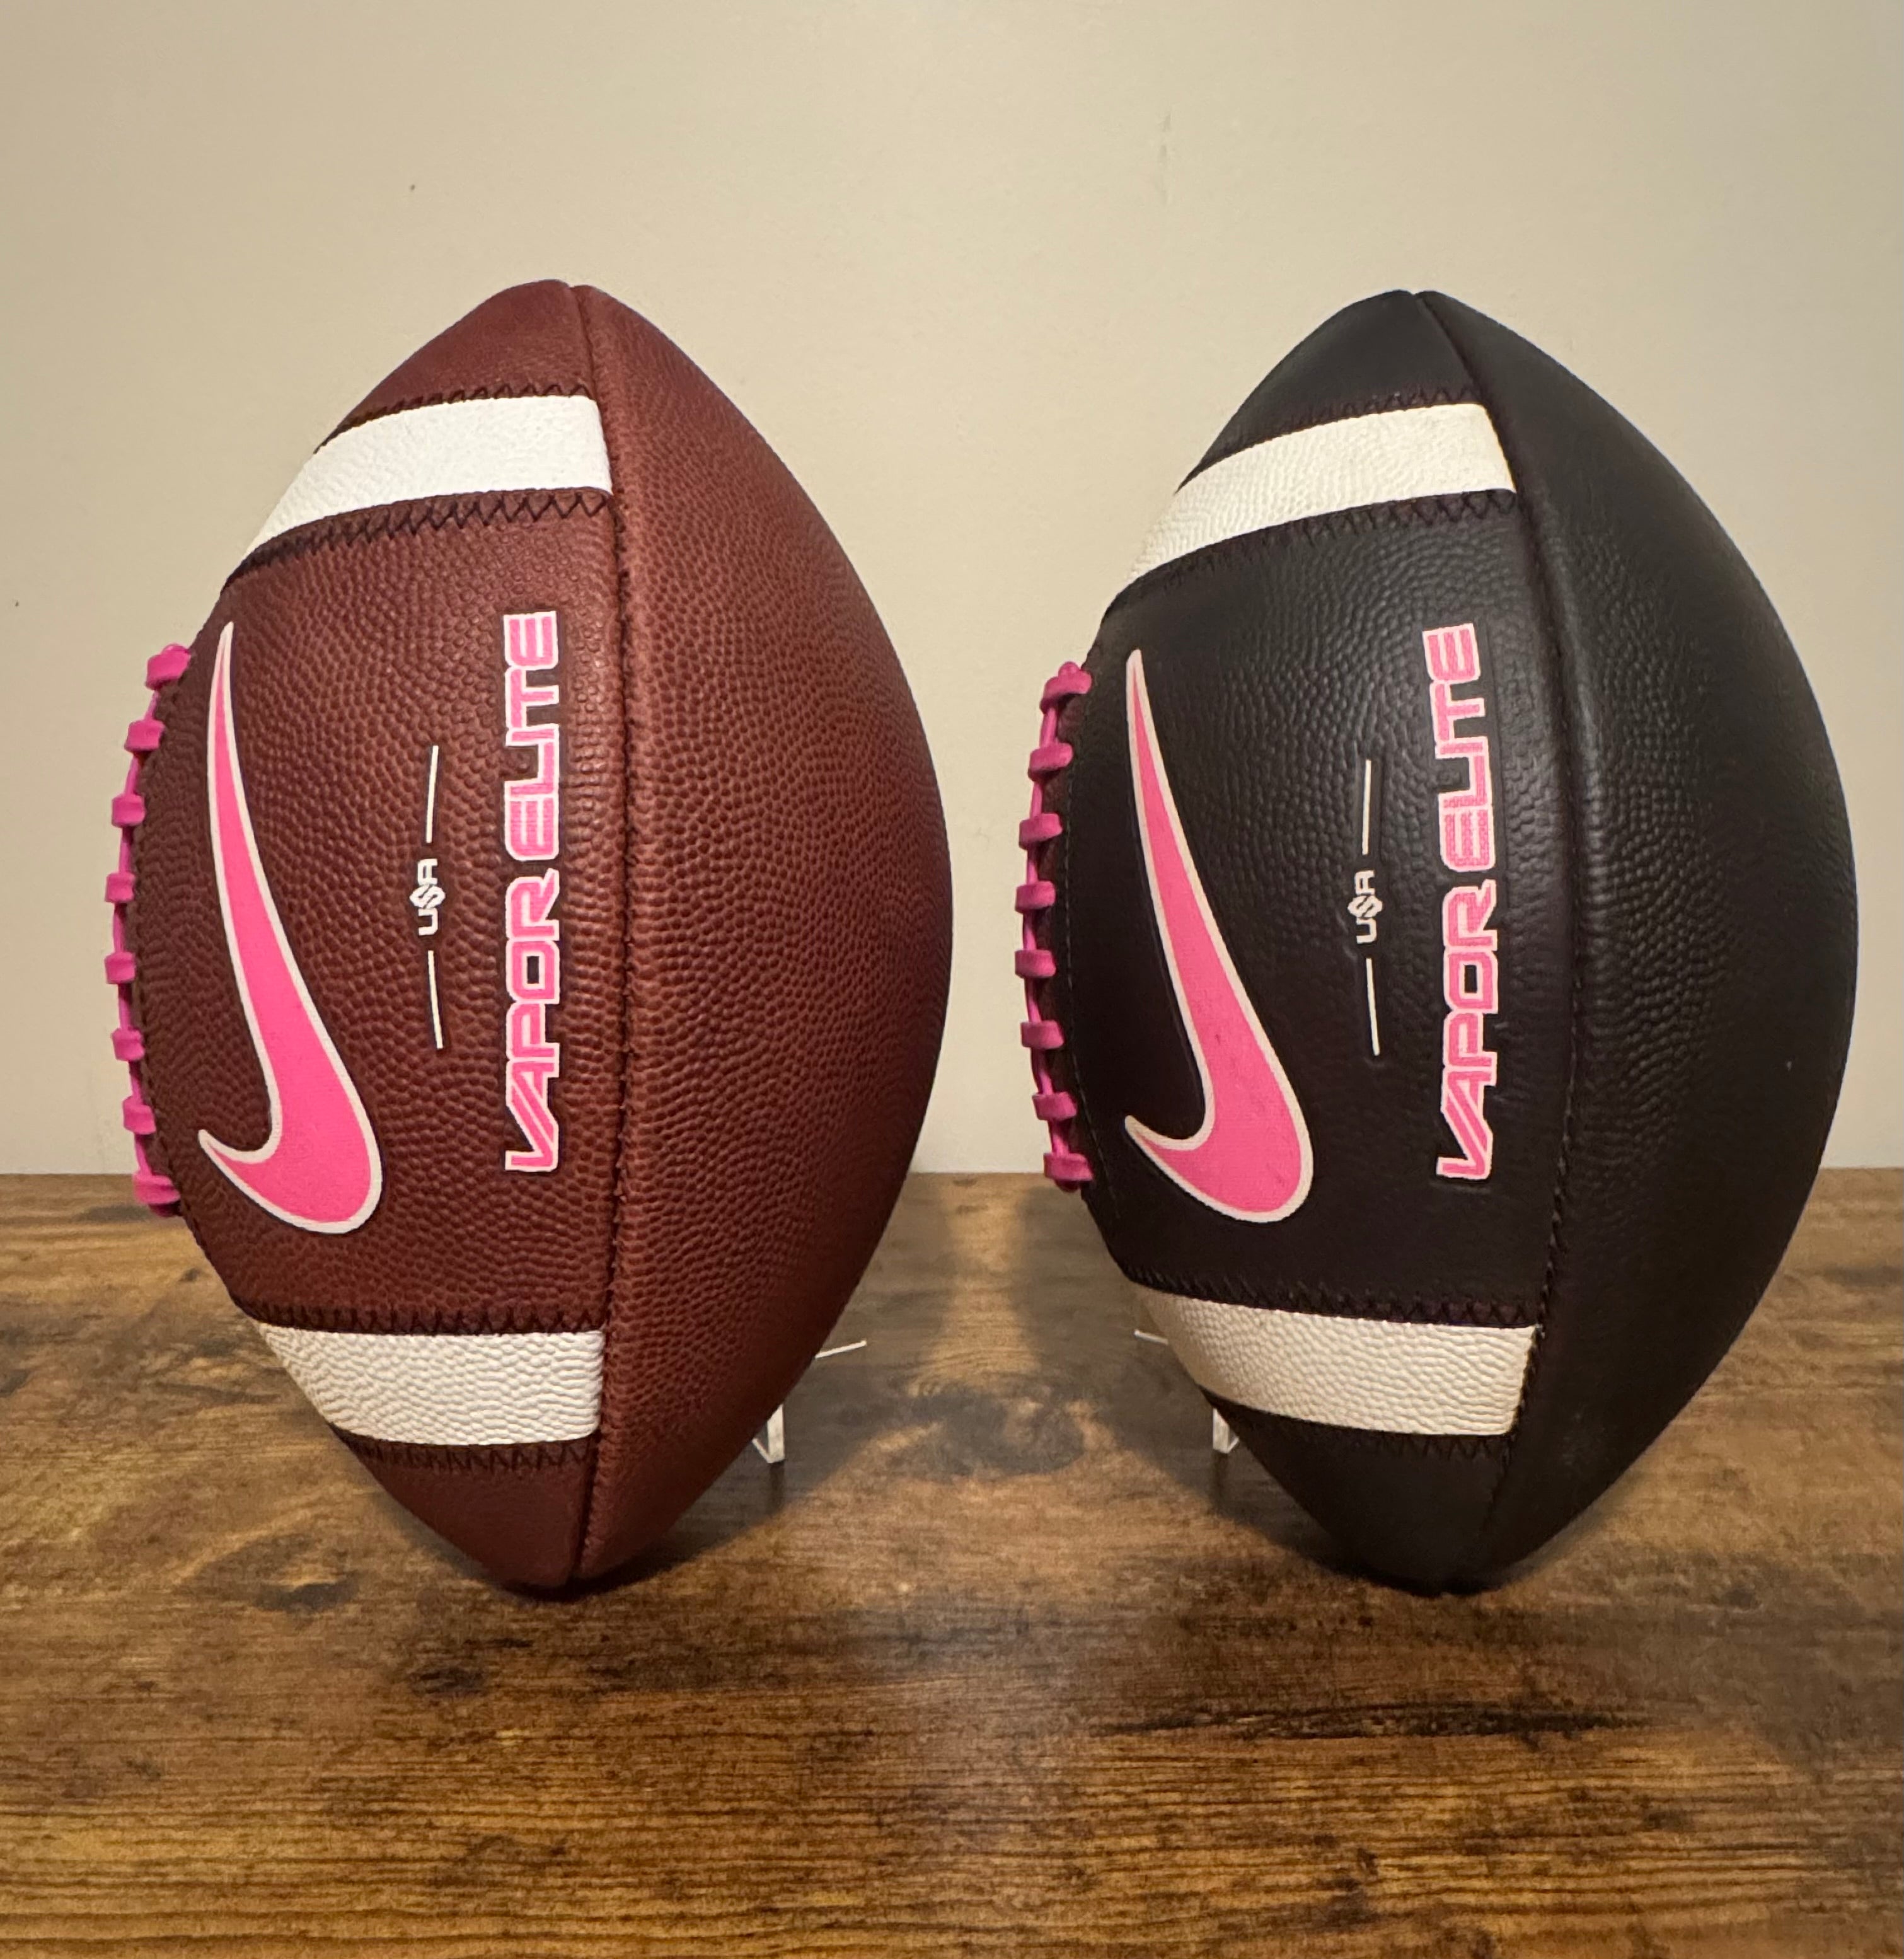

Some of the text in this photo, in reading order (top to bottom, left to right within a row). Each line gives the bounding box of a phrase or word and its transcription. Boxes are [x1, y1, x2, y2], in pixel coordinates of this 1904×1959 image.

[410, 858, 445, 935] USA
[504, 611, 560, 1172] VAPOR ELITE
[1347, 870, 1383, 944] USA
[1422, 623, 1498, 1179] VAPOR ELITE
